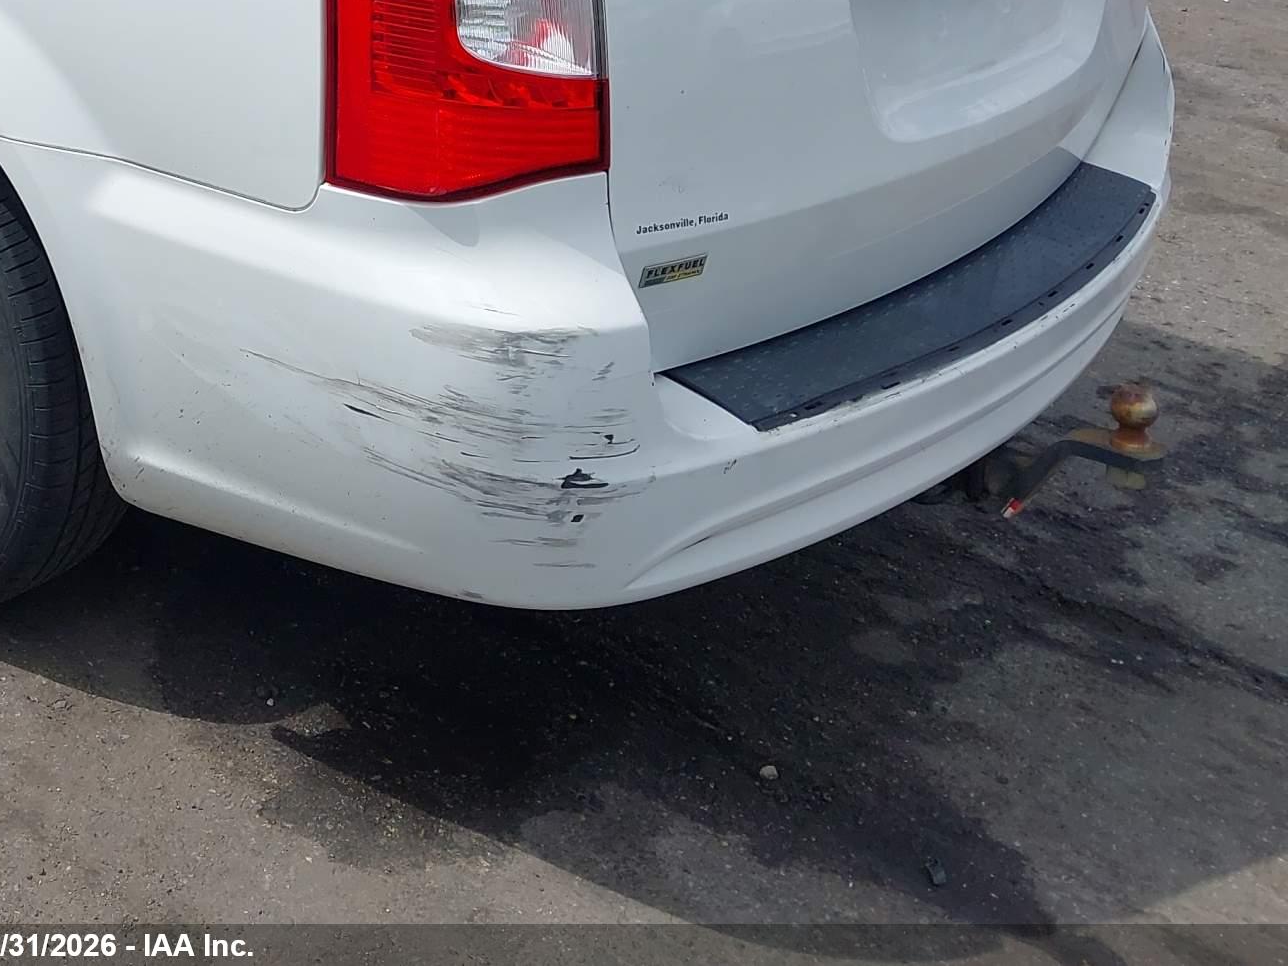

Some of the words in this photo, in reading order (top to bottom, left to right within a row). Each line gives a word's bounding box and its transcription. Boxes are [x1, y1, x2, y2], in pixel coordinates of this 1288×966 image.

[636, 218, 698, 234] Jacksonville,
[698, 212, 729, 225] Florida
[646, 258, 705, 279] FLEXFUEL
